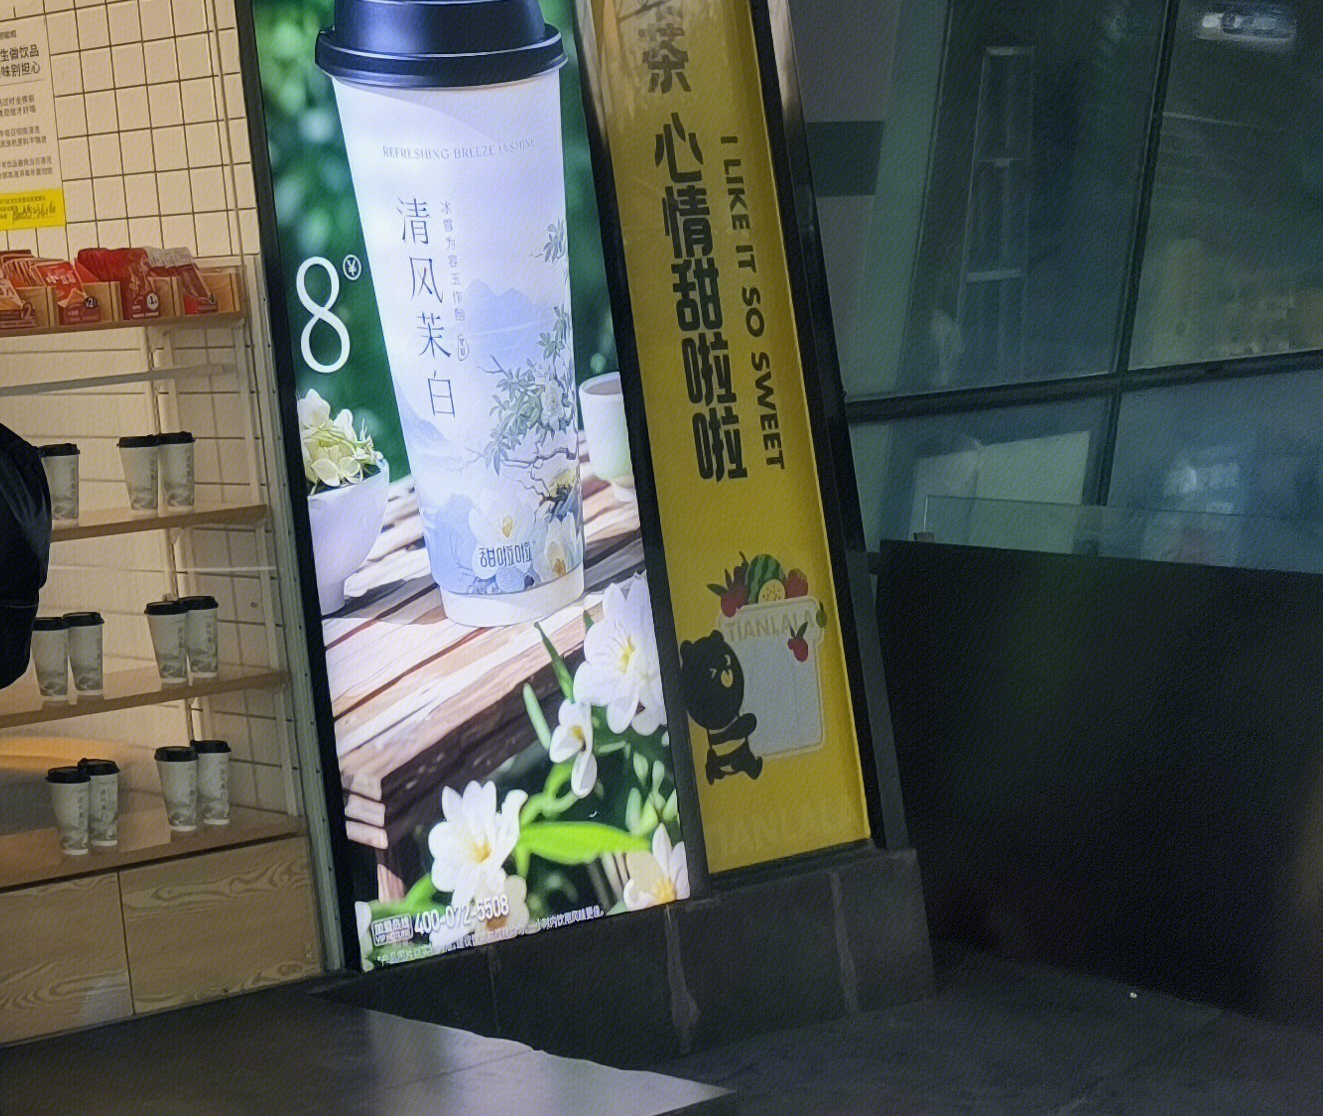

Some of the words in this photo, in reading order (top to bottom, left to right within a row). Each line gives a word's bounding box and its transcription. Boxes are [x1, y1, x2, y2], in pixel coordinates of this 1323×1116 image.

[724, 156, 752, 231] LIKE
[732, 242, 758, 273] IT
[295, 255, 351, 374] 8
[396, 196, 457, 419] 清风茉白
[740, 287, 765, 338] SO
[749, 351, 786, 470] SWEET
[478, 543, 533, 569] 甜啦啦
[414, 893, 510, 935] 400-072-5508
